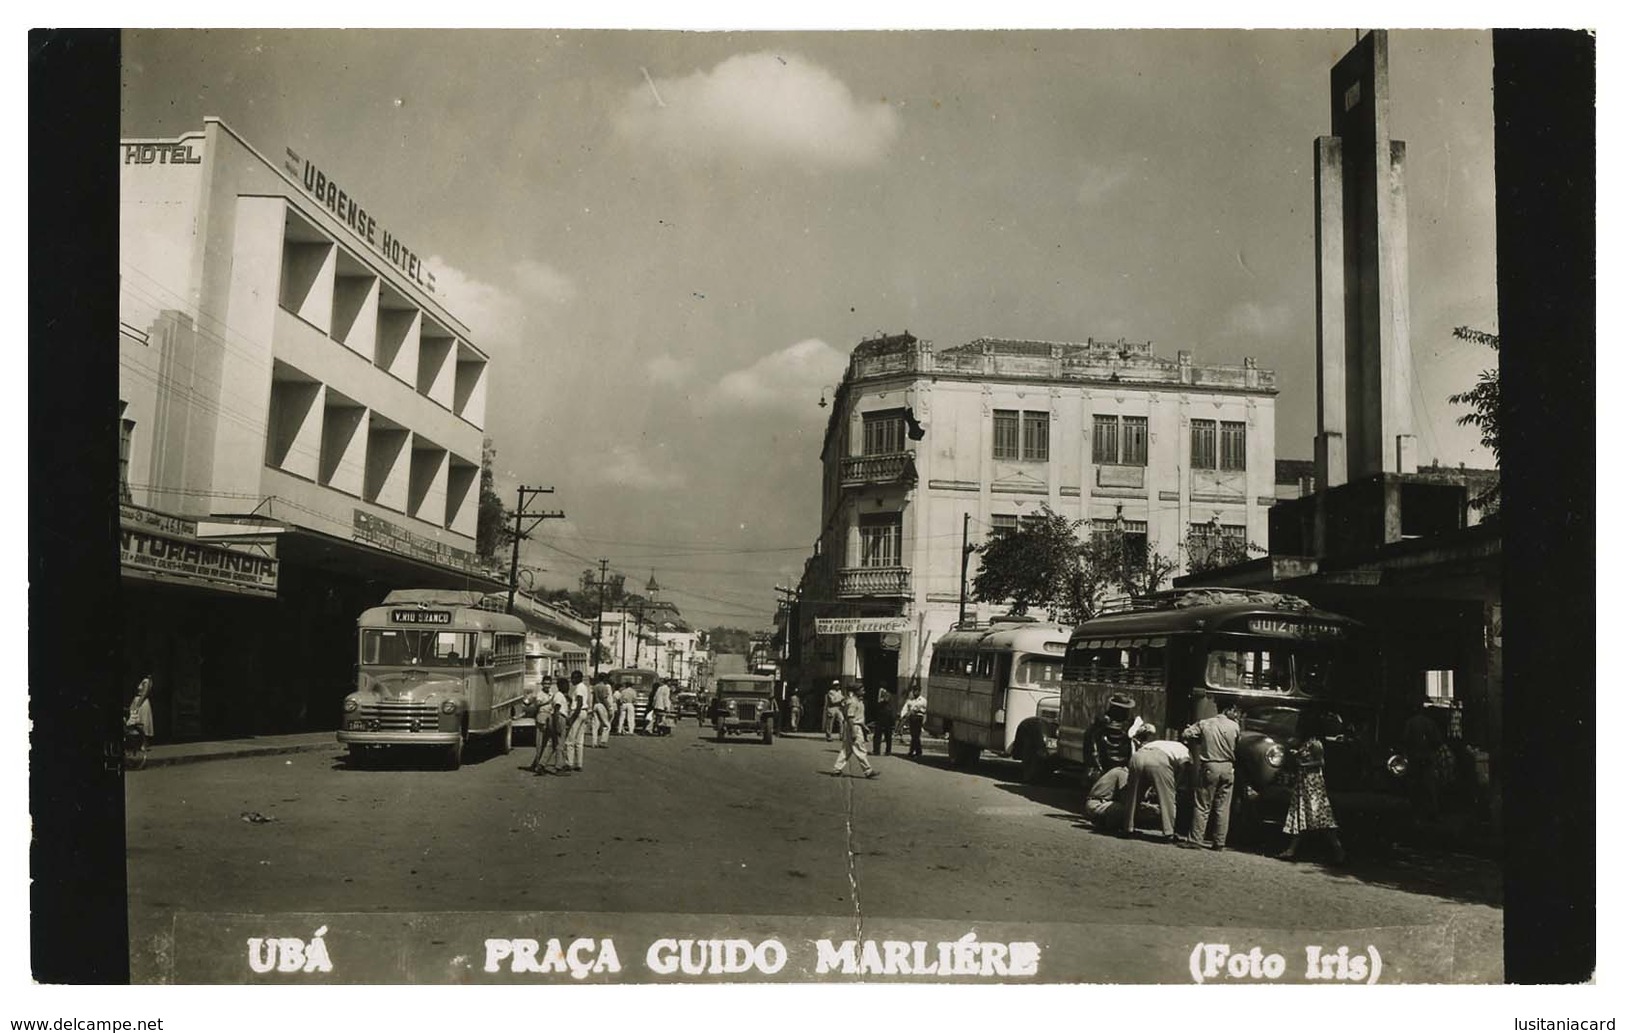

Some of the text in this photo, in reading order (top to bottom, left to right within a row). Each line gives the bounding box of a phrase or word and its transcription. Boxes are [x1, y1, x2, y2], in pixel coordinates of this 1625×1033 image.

[125, 145, 202, 165] HOTEL
[304, 160, 424, 286] UBAENSE HOTEL
[1252, 619, 1287, 633] JUIZ
